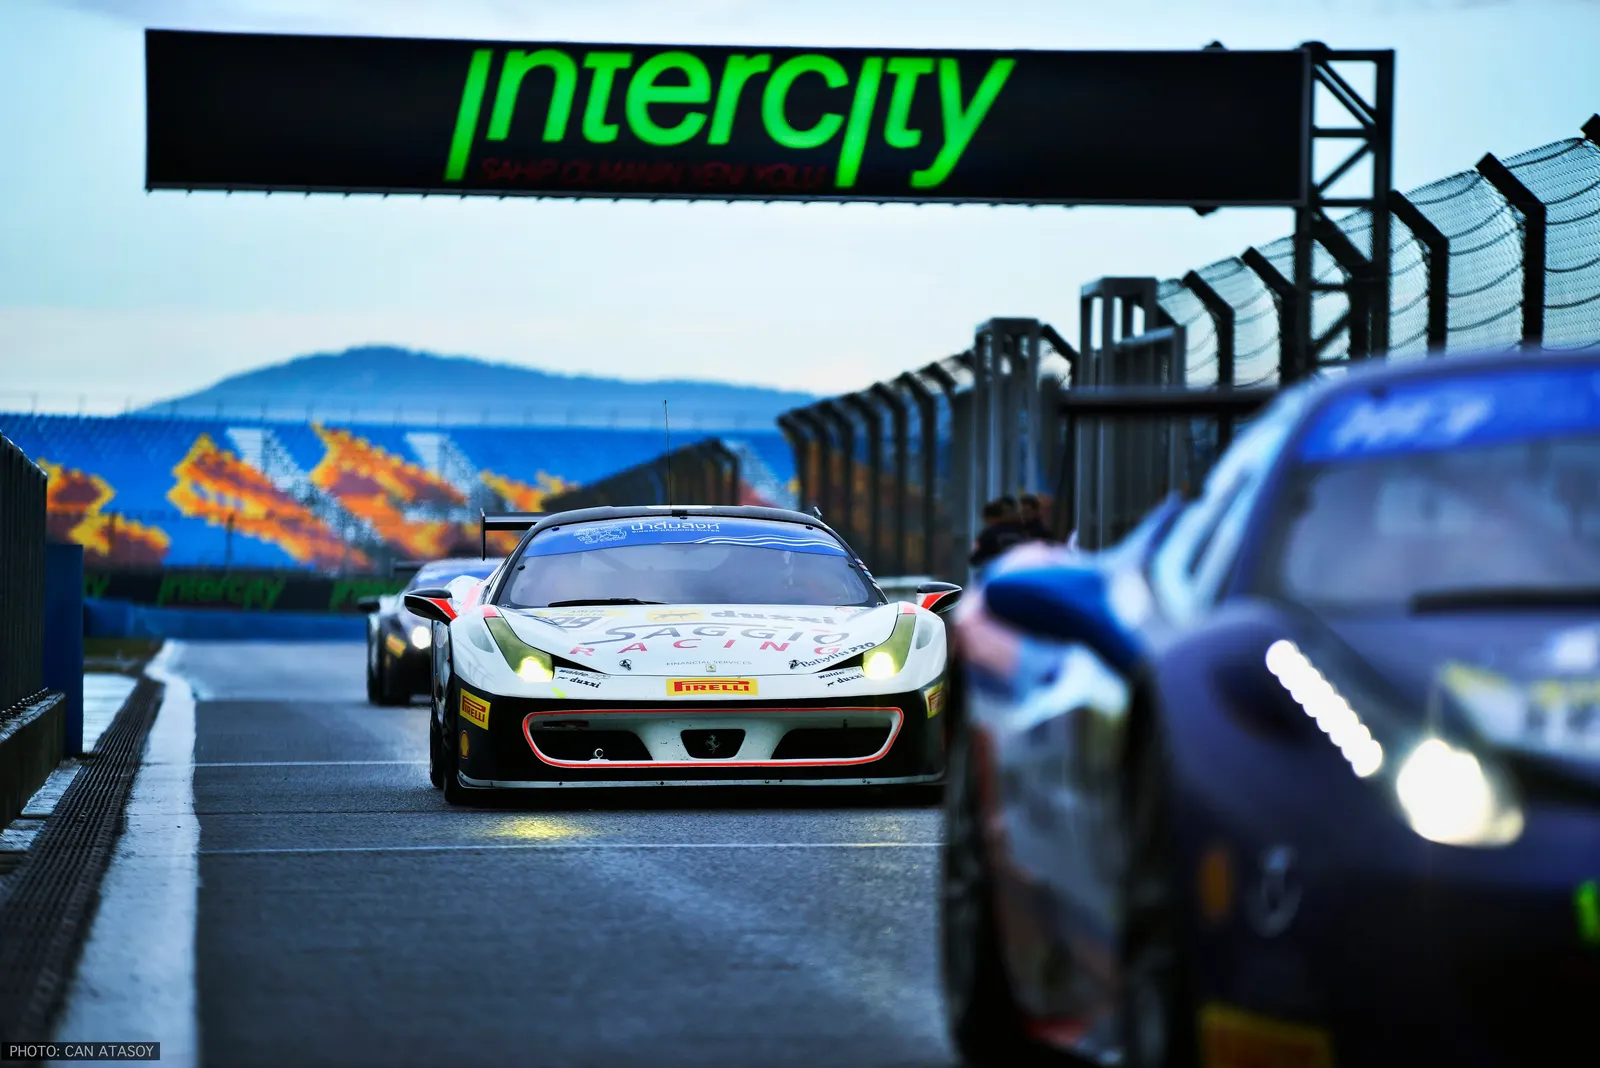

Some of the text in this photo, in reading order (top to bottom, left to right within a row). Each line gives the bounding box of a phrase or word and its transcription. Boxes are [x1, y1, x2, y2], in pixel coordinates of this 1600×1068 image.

[569, 638, 842, 656] RACING
[570, 677, 601, 688] duxxi
[673, 680, 750, 692] PIRELLI
[462, 695, 486, 723] PIRELLI
